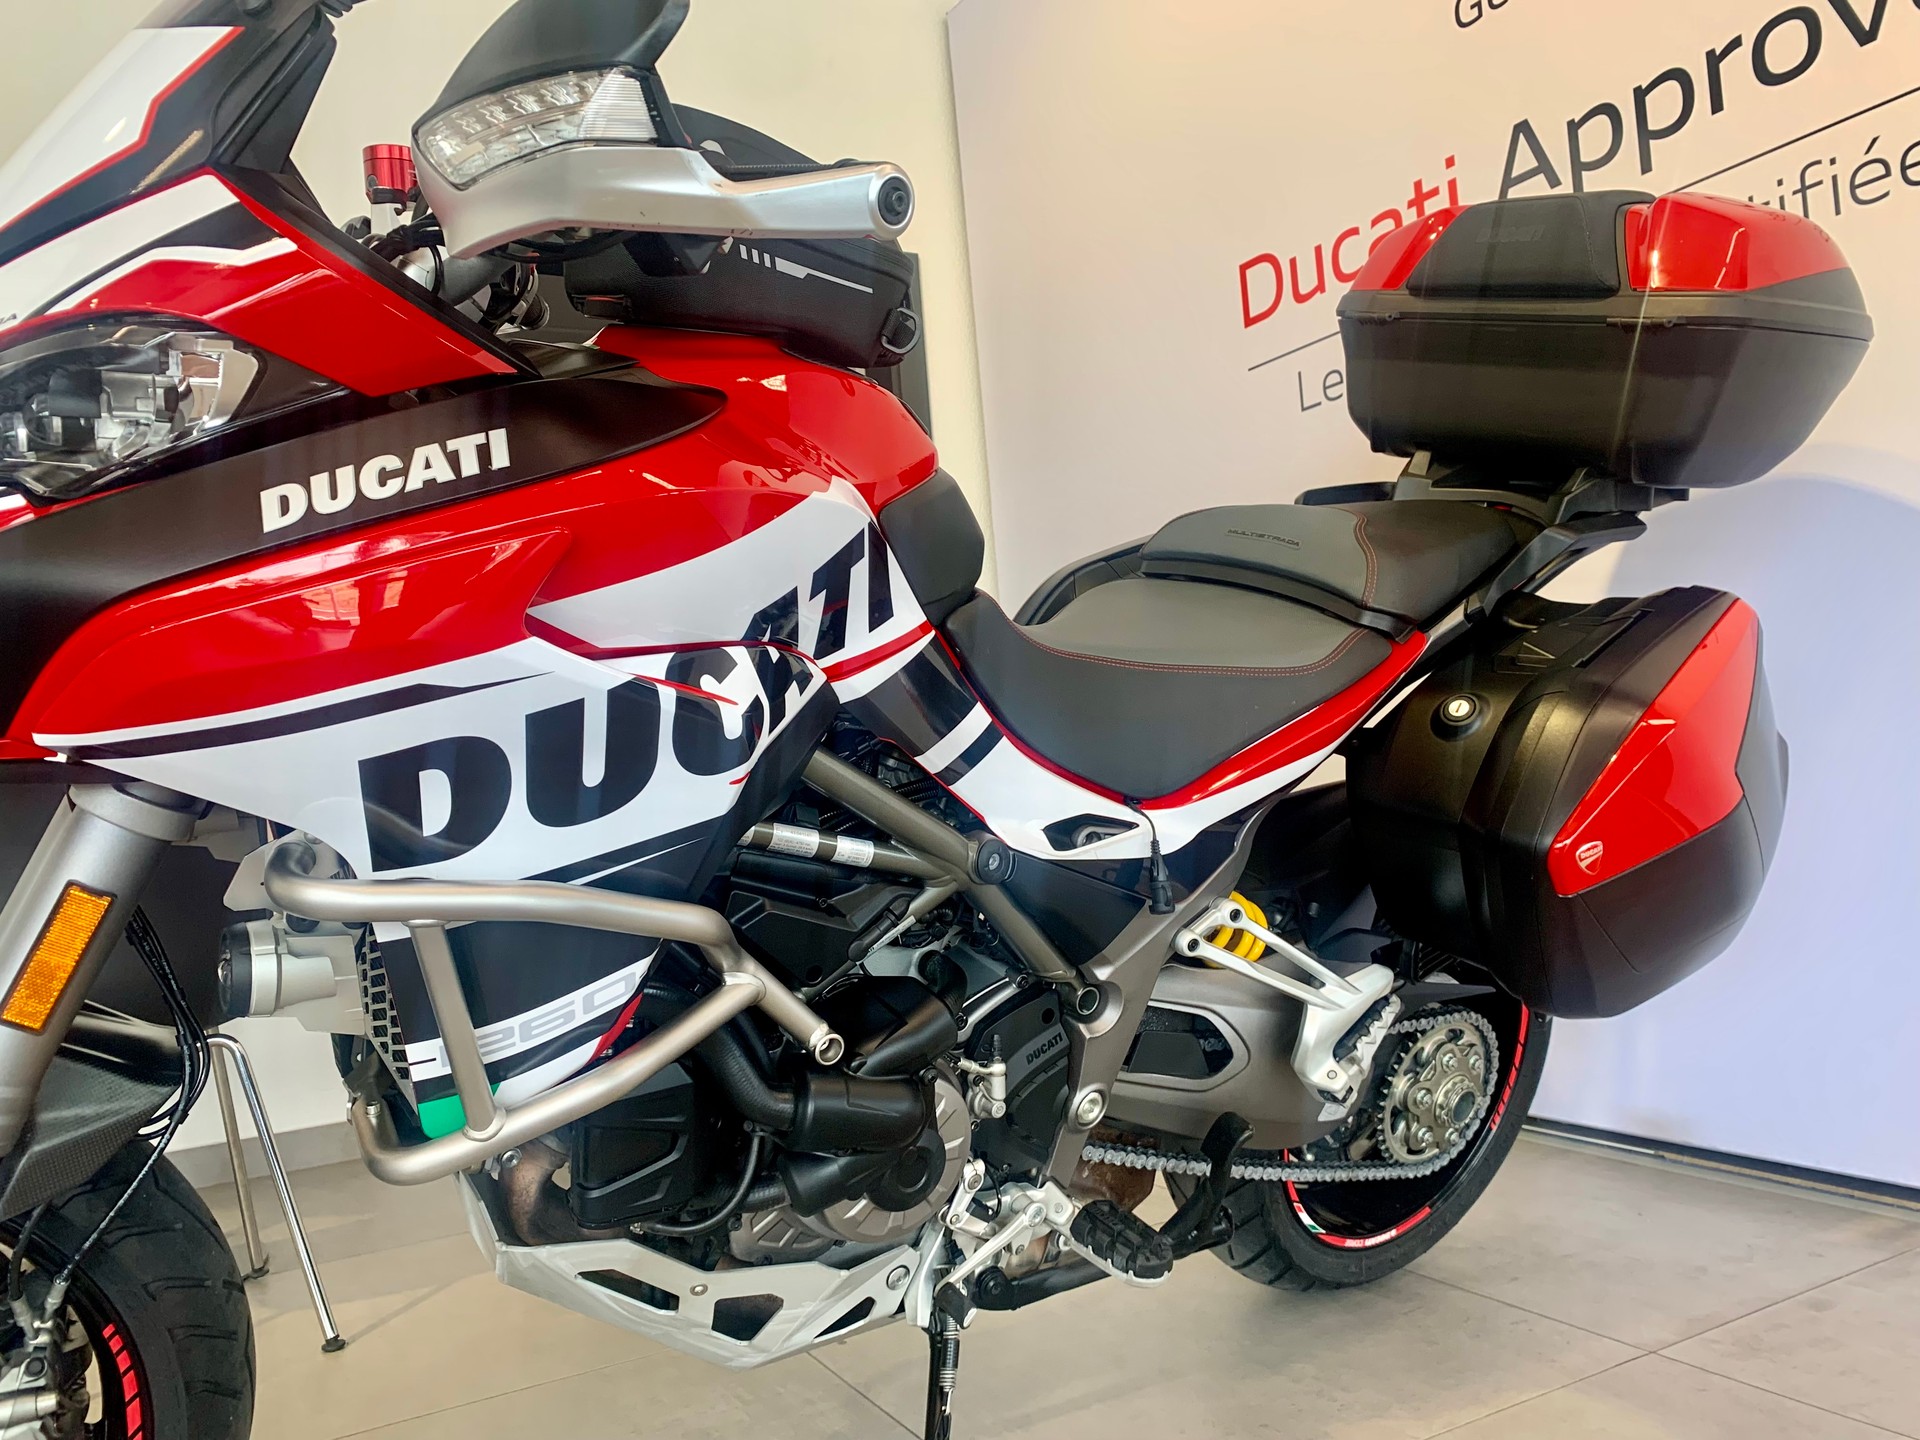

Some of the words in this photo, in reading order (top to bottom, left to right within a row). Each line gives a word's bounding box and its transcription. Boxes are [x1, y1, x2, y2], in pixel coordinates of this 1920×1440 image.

[1498, 0, 1920, 198] Approv
[260, 427, 511, 534] DUCATI
[1227, 528, 1301, 548] MULTISTRADA
[358, 520, 895, 873] DUCATI
[1025, 1031, 1064, 1066] DUCATI
